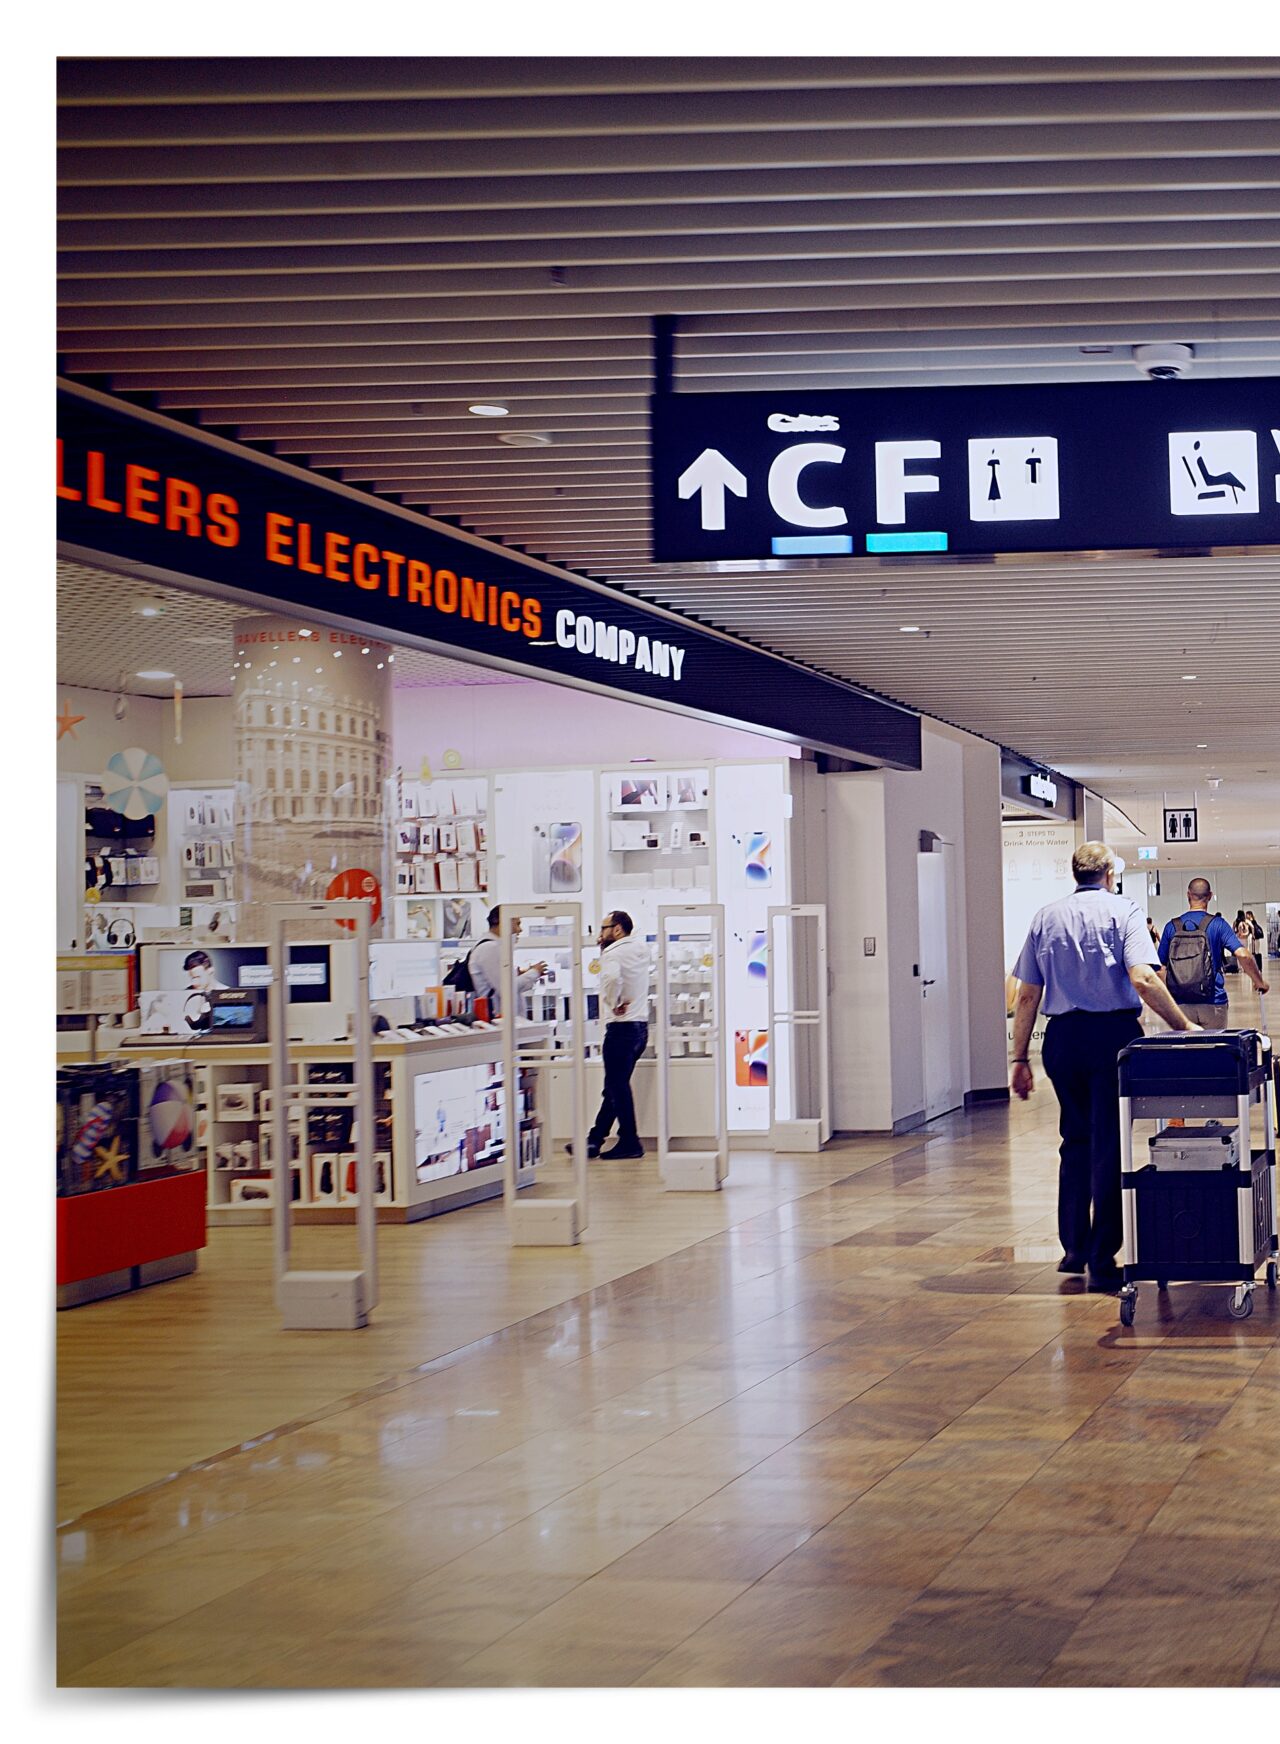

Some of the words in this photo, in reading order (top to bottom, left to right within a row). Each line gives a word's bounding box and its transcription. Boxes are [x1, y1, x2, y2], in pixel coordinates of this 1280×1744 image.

[768, 442, 848, 528] C
[875, 439, 942, 525] F
[265, 511, 543, 639] ELECTRONICS
[555, 609, 686, 681] COMPANY
[1025, 839, 1045, 847] More
